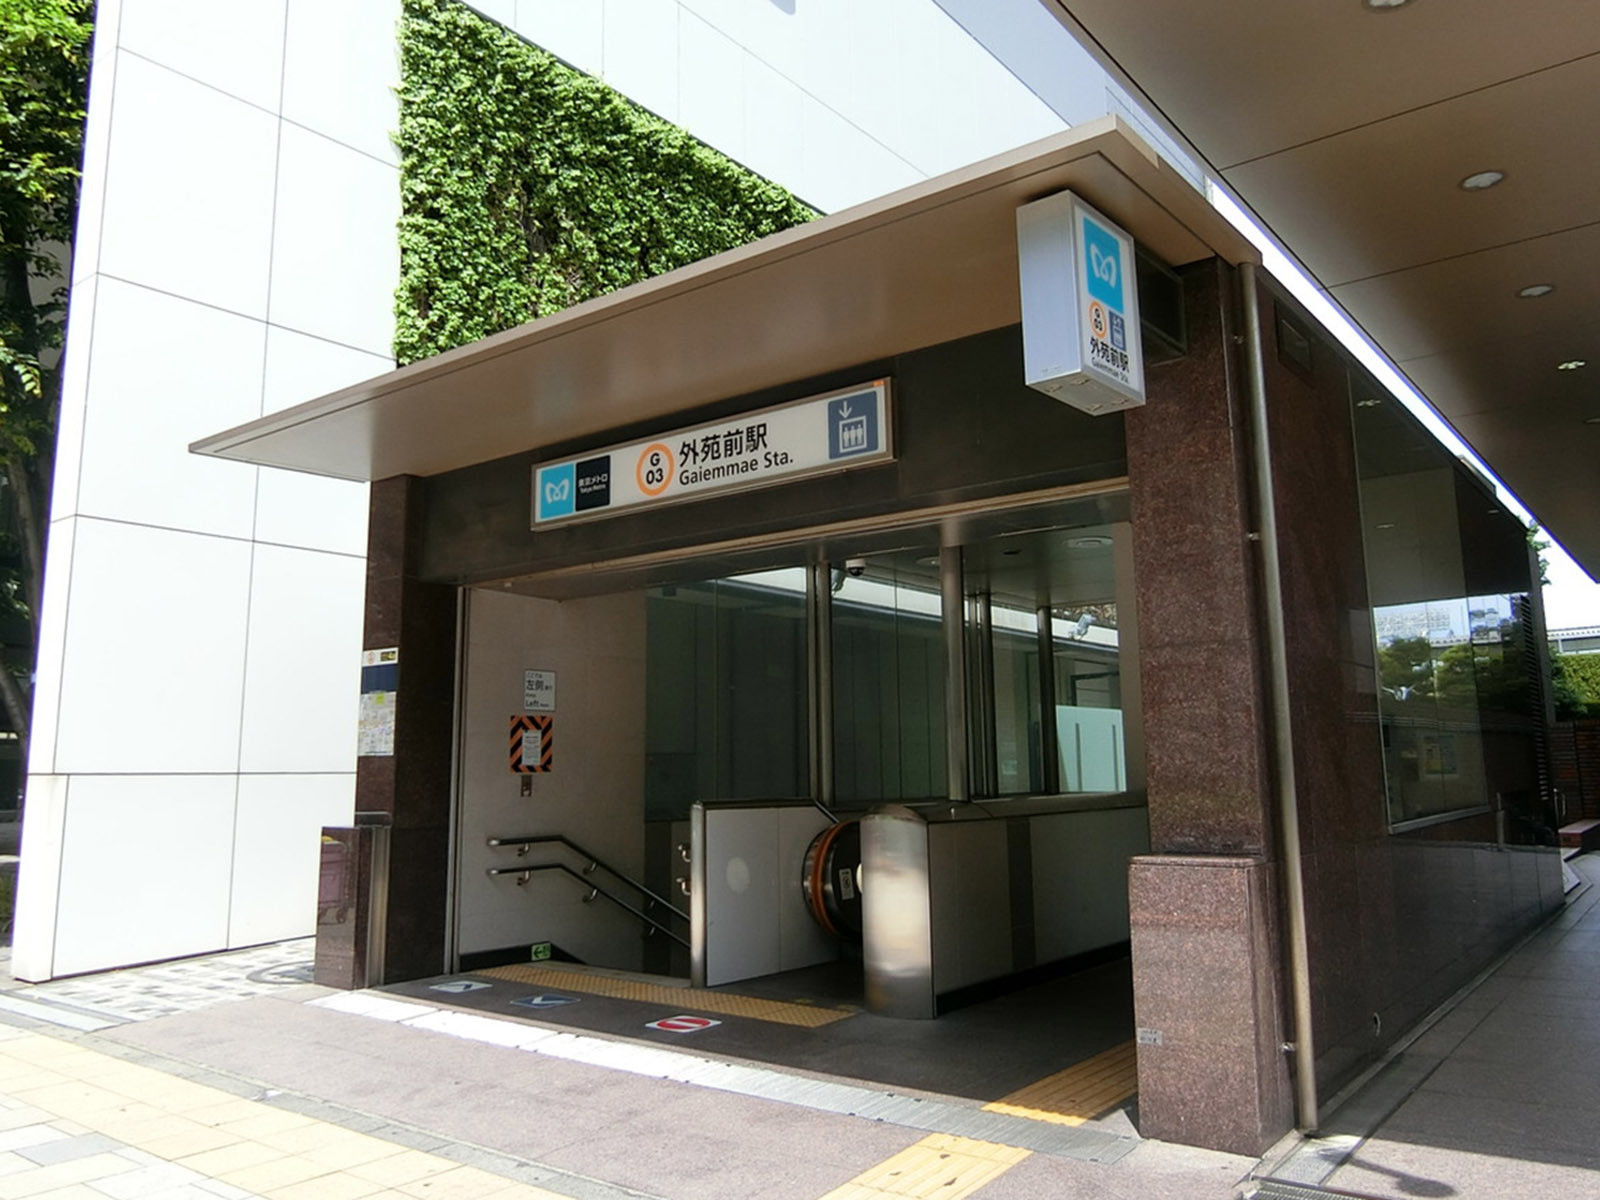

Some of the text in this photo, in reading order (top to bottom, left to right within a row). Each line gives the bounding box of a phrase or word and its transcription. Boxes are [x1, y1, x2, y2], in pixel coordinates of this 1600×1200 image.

[1090, 336, 1130, 373] 外苑前駅
[679, 423, 767, 468] 外苑前駅
[650, 452, 661, 467] G
[679, 451, 794, 486] Gaiemmae Sta.
[578, 473, 608, 488] 東京メトロ
[646, 468, 664, 485] 03
